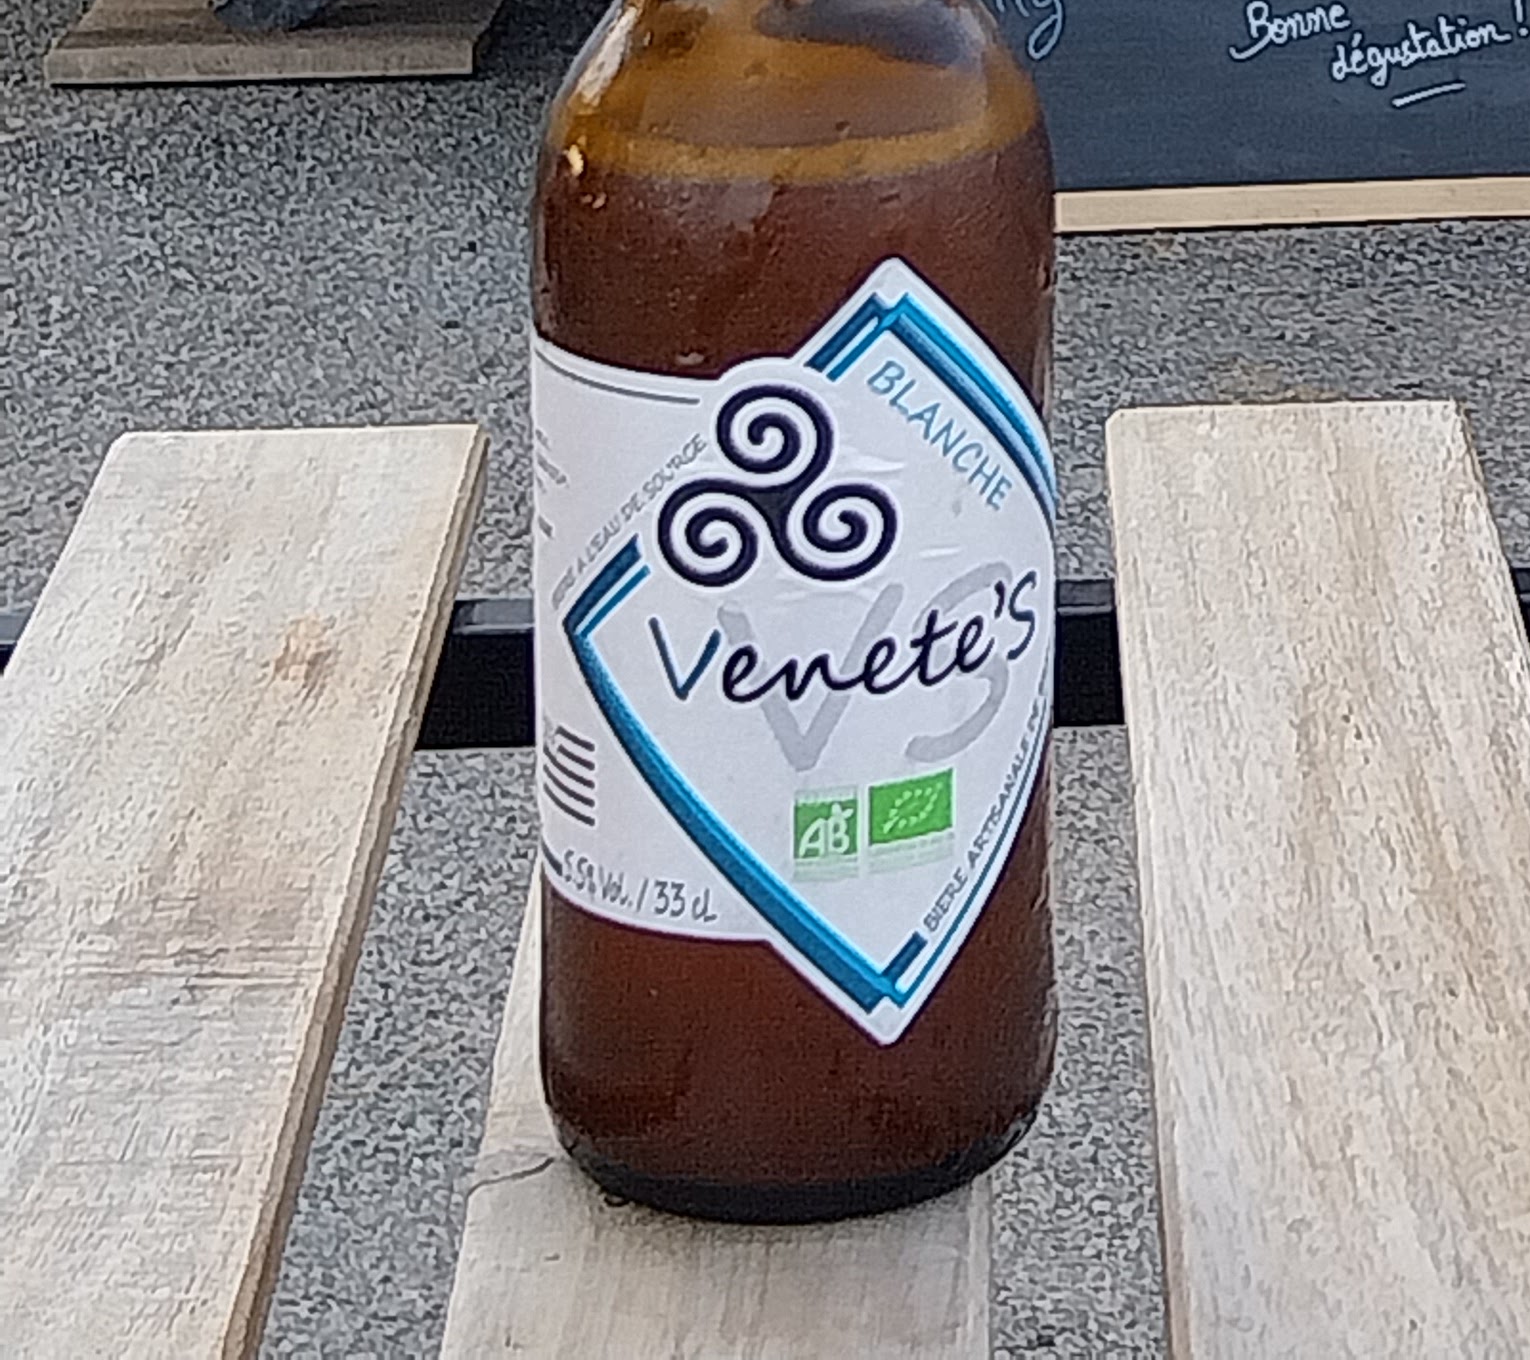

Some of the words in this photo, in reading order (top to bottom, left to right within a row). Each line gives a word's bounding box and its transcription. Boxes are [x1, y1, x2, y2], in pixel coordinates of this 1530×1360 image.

[866, 359, 1013, 513] BLANCHE
[653, 880, 686, 918] 33
[923, 866, 969, 935] BIERE
[967, 731, 1029, 870] ARTISANALE
